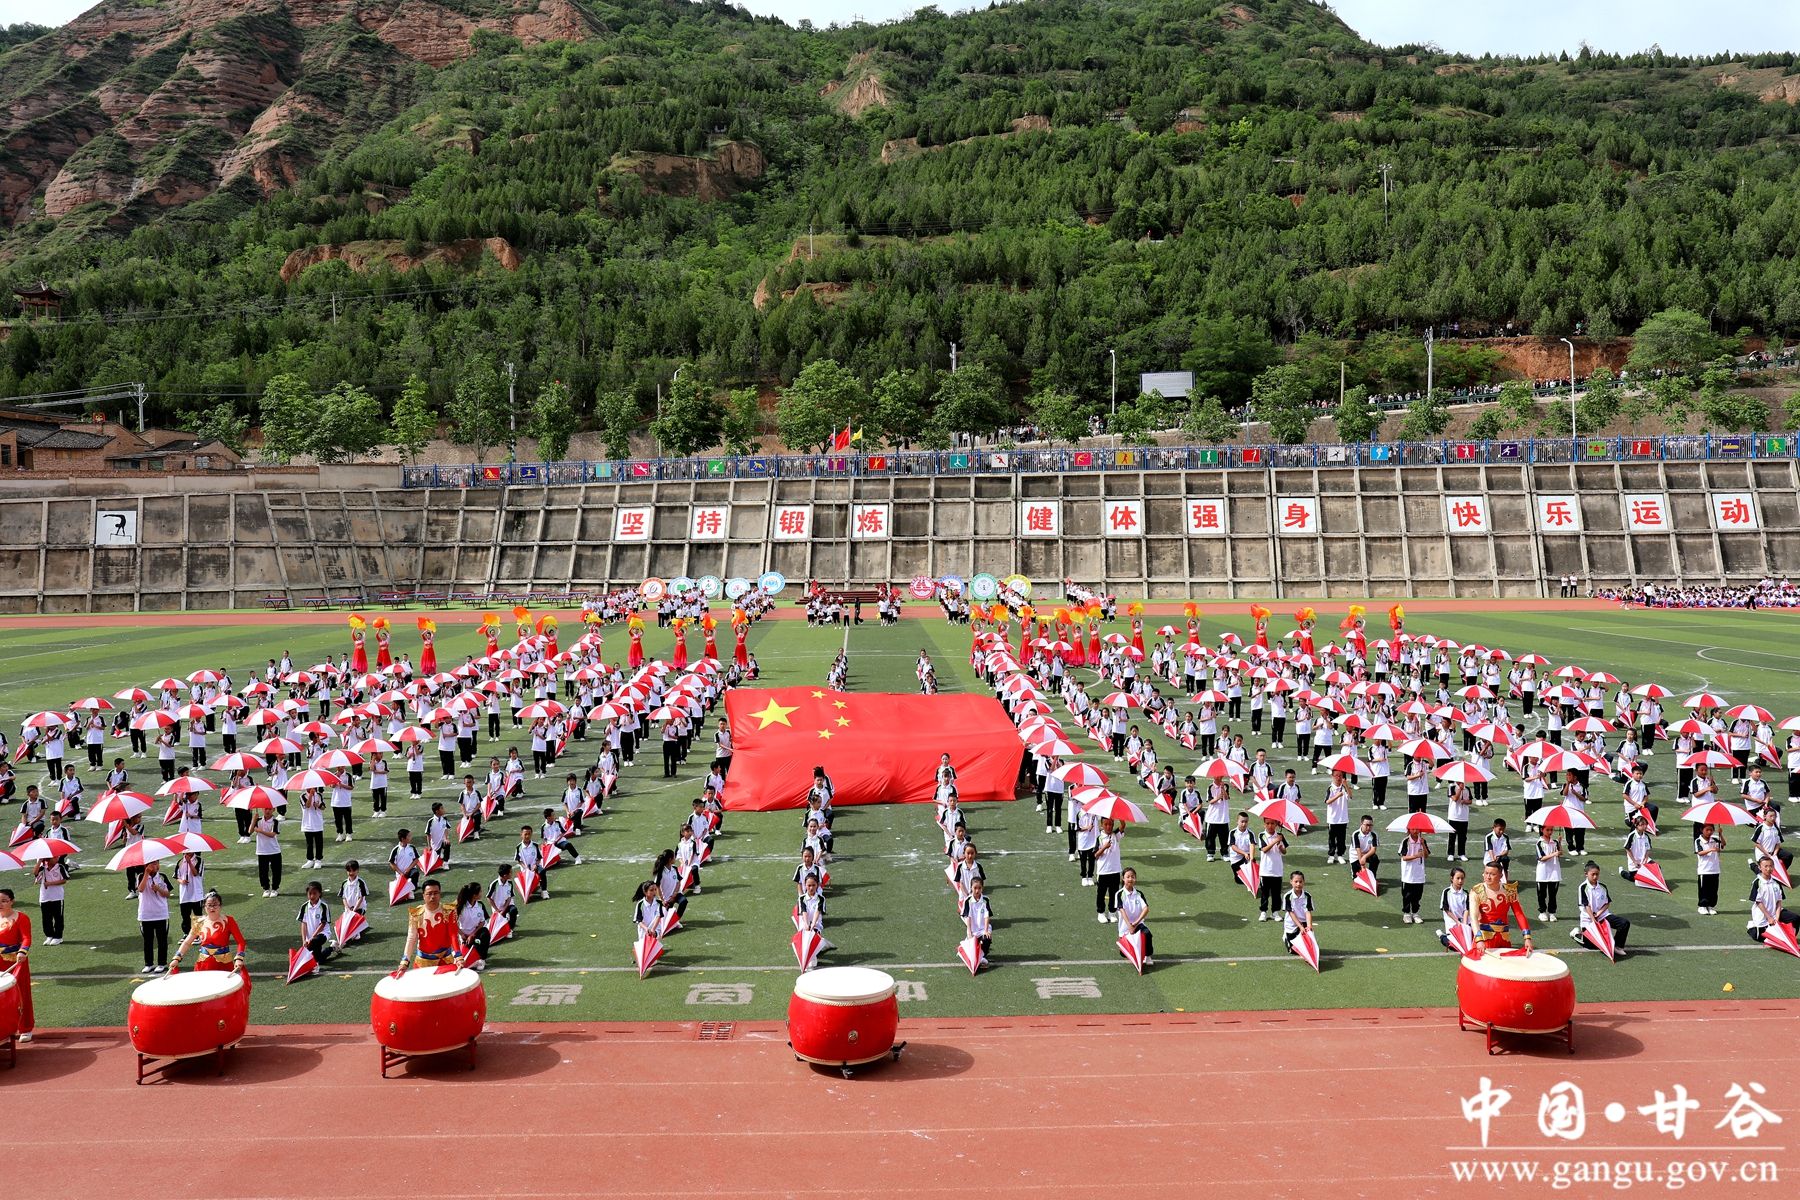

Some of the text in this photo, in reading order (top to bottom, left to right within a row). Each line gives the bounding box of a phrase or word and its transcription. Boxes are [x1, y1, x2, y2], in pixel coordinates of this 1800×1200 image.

[621, 498, 1751, 536] 坚持锻炼 健体强身 快乐运动
